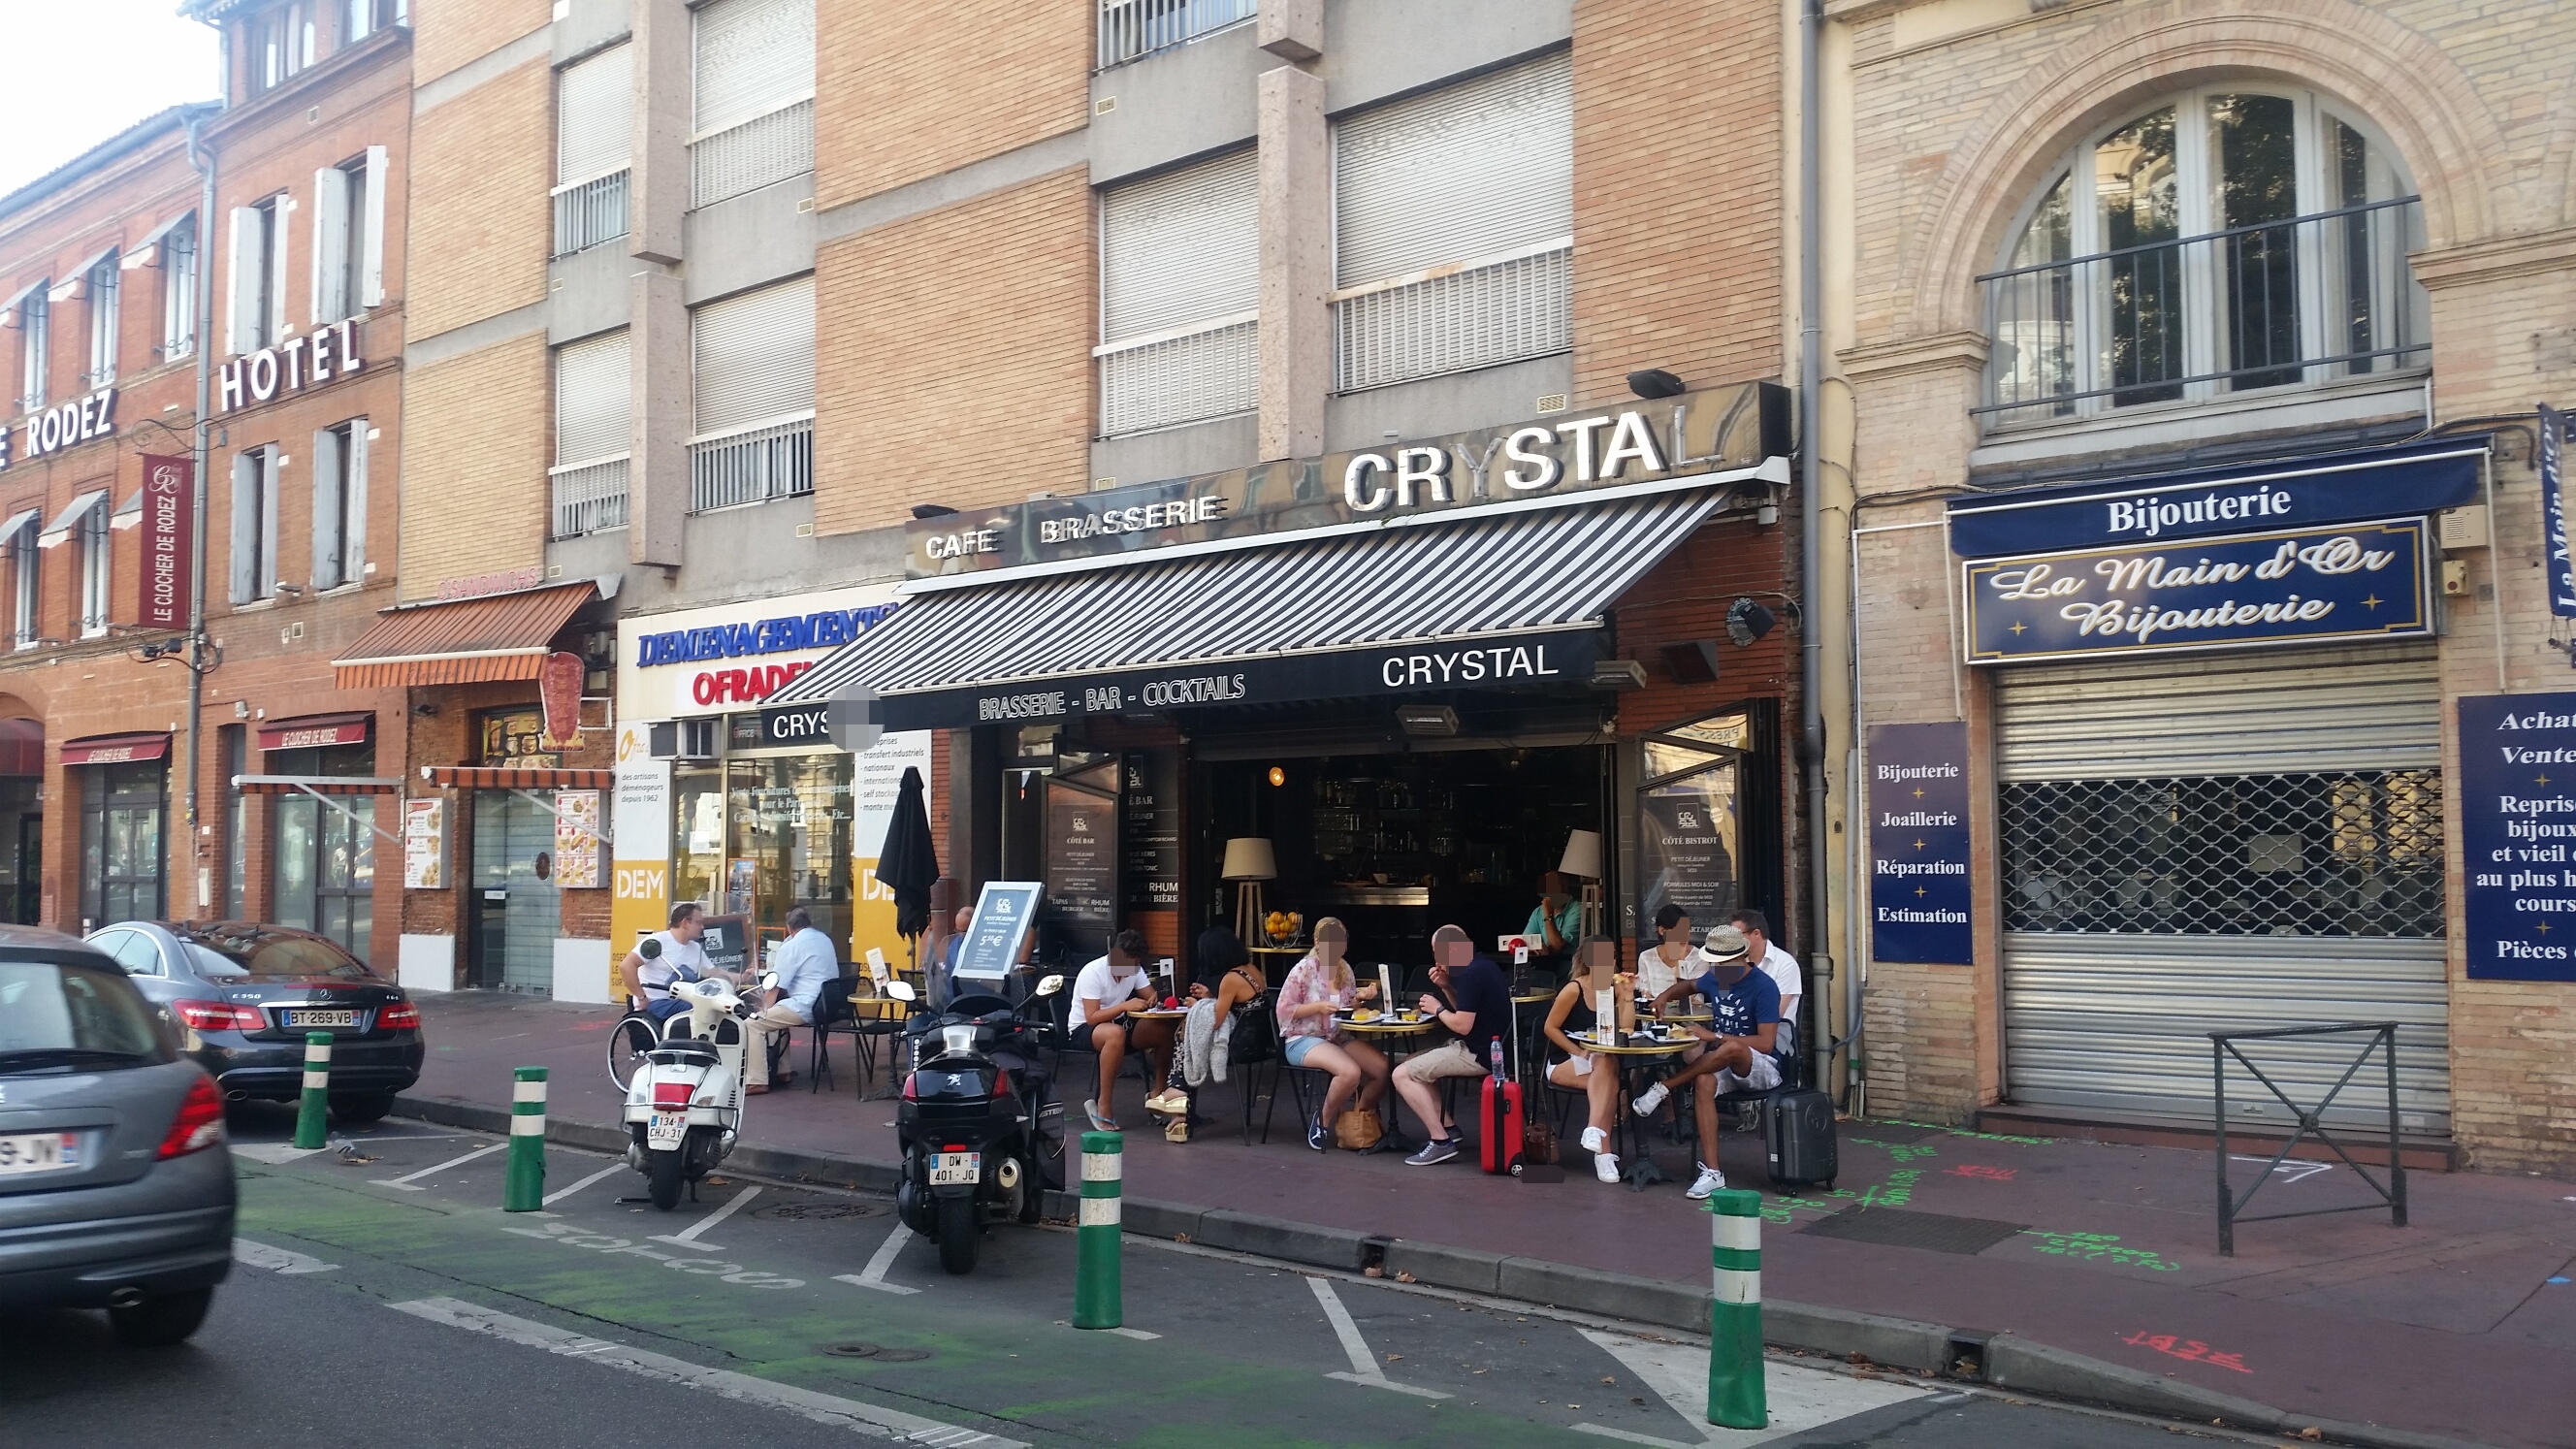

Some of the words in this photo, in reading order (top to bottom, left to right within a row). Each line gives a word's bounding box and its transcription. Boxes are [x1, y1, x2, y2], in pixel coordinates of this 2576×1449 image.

[219, 320, 362, 412] HOTEL
[26, 388, 114, 458] RODEZ
[1344, 404, 1722, 512] CRYSTAL
[156, 495, 177, 533] RODEZ
[2107, 485, 2292, 536] Bijouterie
[925, 529, 997, 560] CAFE
[1041, 495, 1220, 544] BRASSERIE
[155, 535, 176, 552] DE
[1989, 564, 2086, 601] La
[2094, 557, 2250, 592] Main
[2255, 535, 2396, 581] d'Or
[154, 555, 175, 605] CLOCHER
[153, 608, 173, 622] LE
[2059, 594, 2335, 645] Bijouterie
[1382, 644, 1560, 689] CRYSTAL
[692, 661, 814, 706] OFRAD
[979, 692, 1066, 721] BRASSERIE
[1085, 686, 1122, 711] BAR
[1143, 674, 1246, 707] COCKTAILS
[876, 737, 898, 747] eprises
[863, 750, 890, 760] transfert
[891, 748, 924, 758] industriels
[2500, 747, 2576, 764] Vente
[863, 763, 895, 772] nationaux
[1877, 762, 1959, 784] Bijouterie
[633, 772, 659, 781] artisans
[863, 776, 902, 786] internationa
[621, 783, 664, 792] déménageurs
[863, 789, 874, 798] self
[621, 794, 642, 804] depuis
[643, 794, 659, 803] 1962
[1136, 795, 1153, 805] BAR
[1881, 811, 1957, 828] Joaillerie
[1662, 835, 1685, 846] CÔTÉ
[1685, 836, 1718, 845] BISTROT
[2492, 847, 2512, 862] et
[2518, 845, 2566, 862] vieil
[1876, 859, 1965, 879] Réparation
[616, 869, 664, 899] DEM
[1149, 882, 1178, 892] RHUM
[2476, 874, 2503, 887] au
[2510, 872, 2558, 891] plus
[1153, 892, 1178, 903] BIÈRE
[1878, 907, 1968, 923] Estimation
[2496, 940, 2567, 959] Pièces
[291, 1012, 352, 1025] BT-269-VB
[500, 1222, 806, 1290] MOTOS
